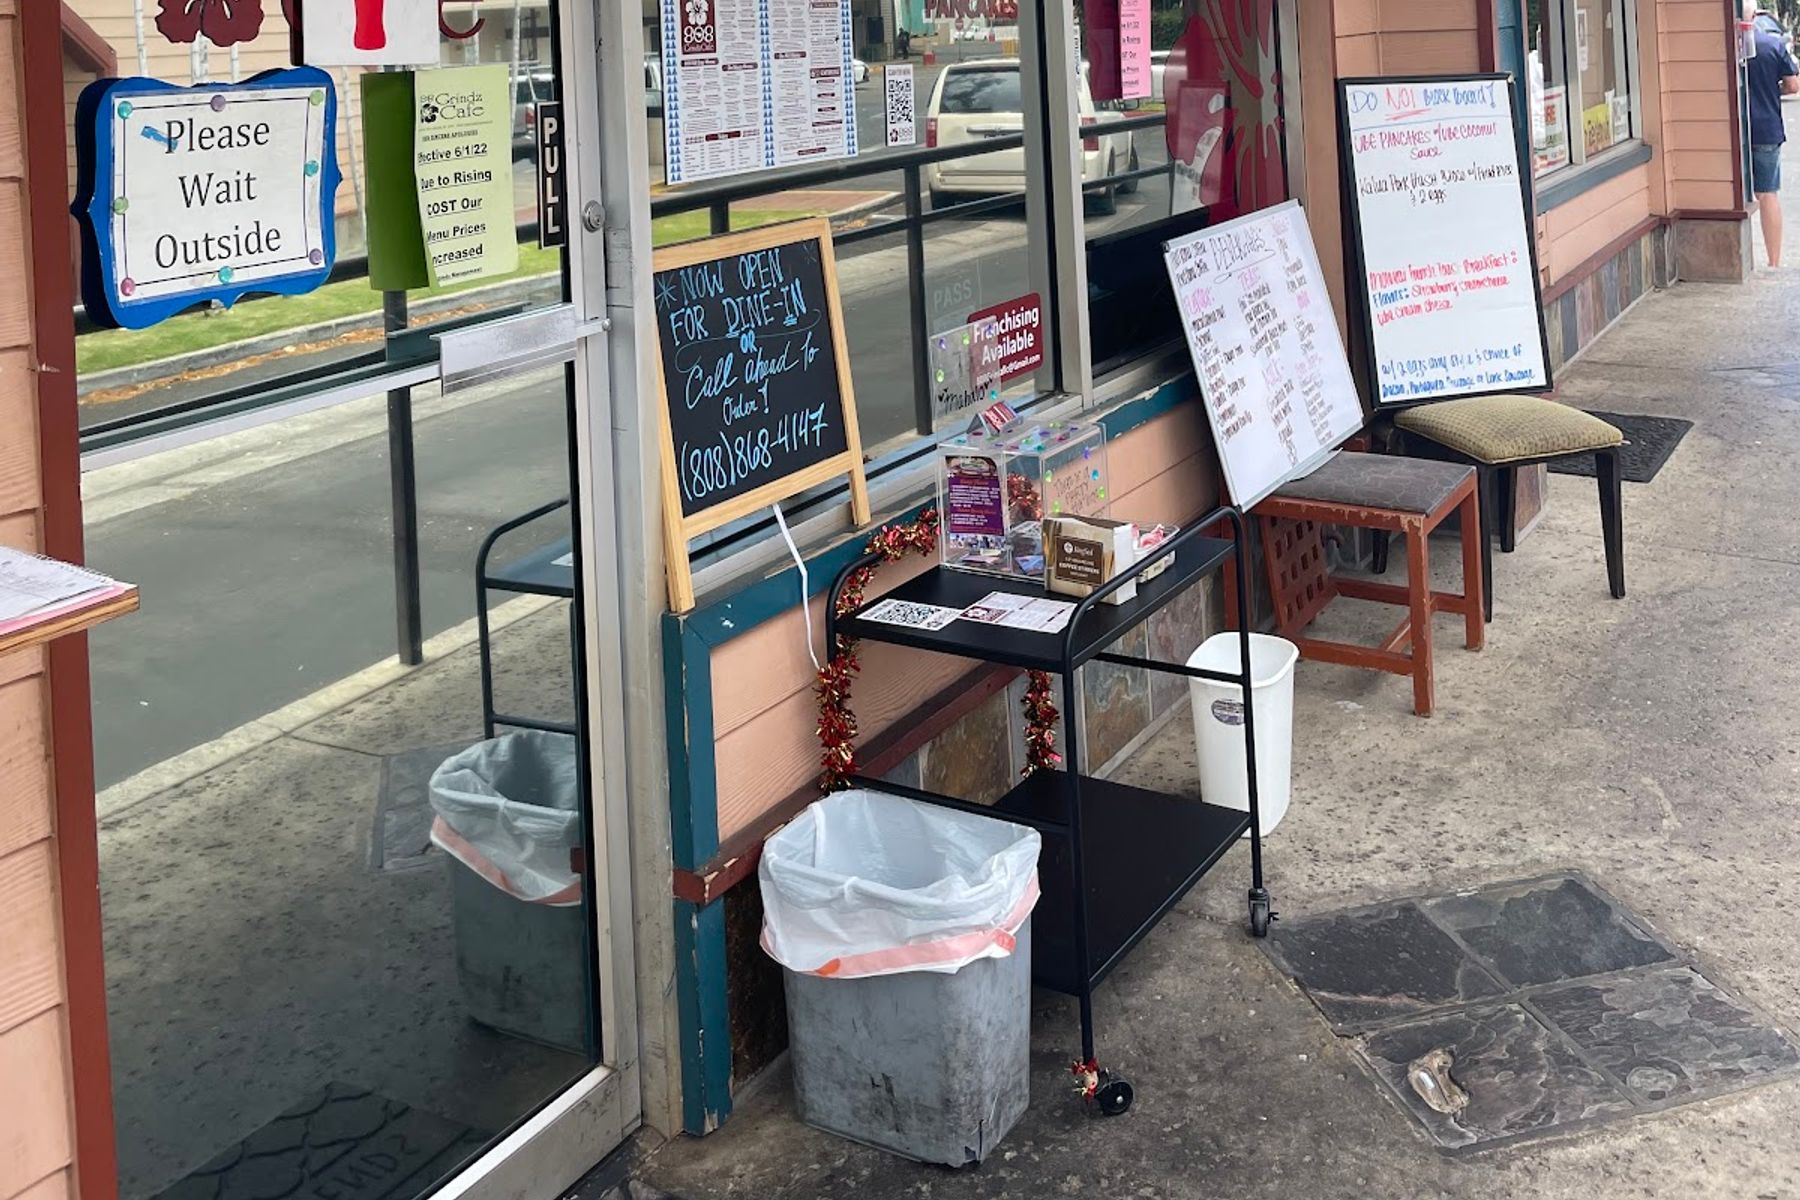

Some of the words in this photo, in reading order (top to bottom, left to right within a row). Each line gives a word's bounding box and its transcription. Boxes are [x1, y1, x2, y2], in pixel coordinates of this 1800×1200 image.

[684, 25, 714, 43] 808
[435, 91, 483, 105] Grindz
[440, 102, 485, 119] Cafe
[1350, 90, 1377, 113] DO
[164, 117, 270, 154] Please
[454, 143, 488, 158] 6/1/22
[1379, 129, 1432, 150] PANCAKES
[178, 170, 258, 209] Wait
[438, 175, 450, 186] to
[454, 170, 492, 184] Rising
[543, 116, 560, 234] PULL
[461, 197, 482, 210] Our
[155, 220, 281, 268] Outside
[453, 222, 486, 237] Prices
[680, 261, 724, 306] NOW
[738, 248, 784, 291] OPEN
[670, 304, 708, 346] FOR
[722, 277, 807, 338] DINE-IN
[973, 305, 1039, 343] Franchising
[740, 331, 758, 354] OR
[981, 329, 1035, 365] Available
[685, 352, 739, 409] Call
[745, 341, 799, 384] ahead
[722, 377, 769, 426] Order!
[681, 402, 828, 502] (808)868-4147
